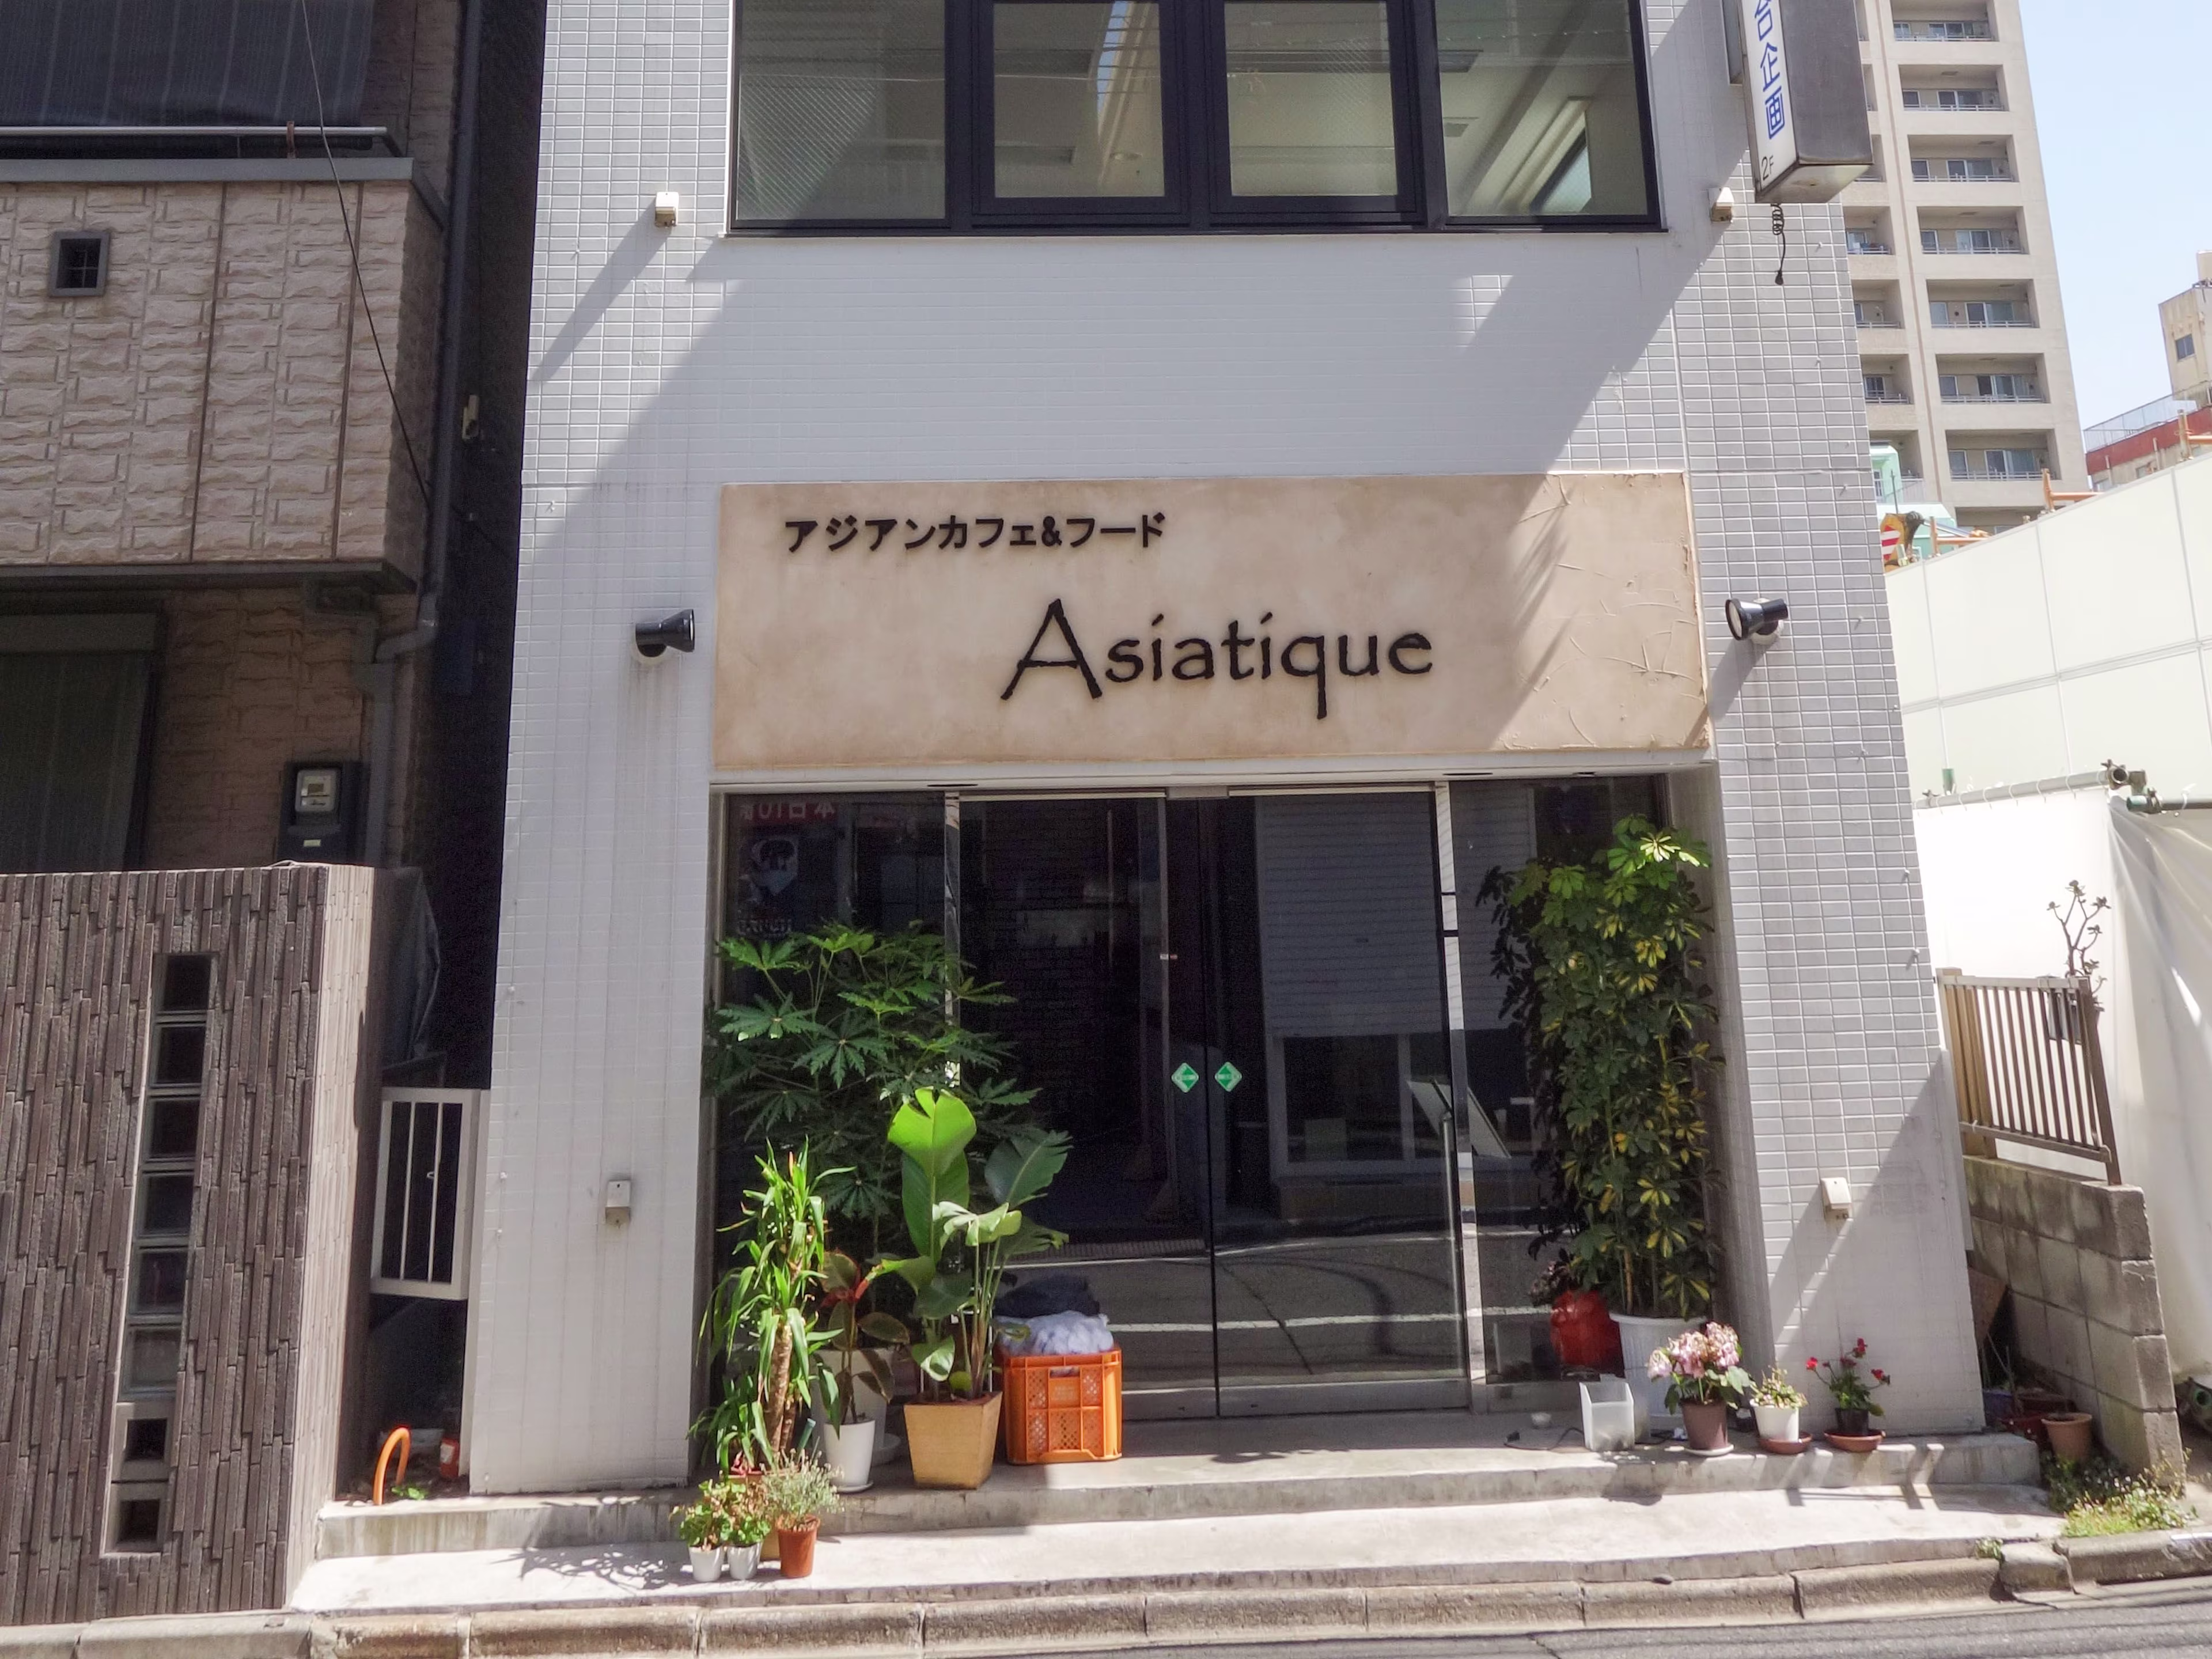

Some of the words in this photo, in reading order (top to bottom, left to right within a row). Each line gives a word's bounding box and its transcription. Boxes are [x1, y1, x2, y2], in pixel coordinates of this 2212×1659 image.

[1762, 155, 1774, 181] 2F
[785, 512, 1165, 553] アジアンカフェ&フード
[1000, 598, 1433, 721] Asiatique
